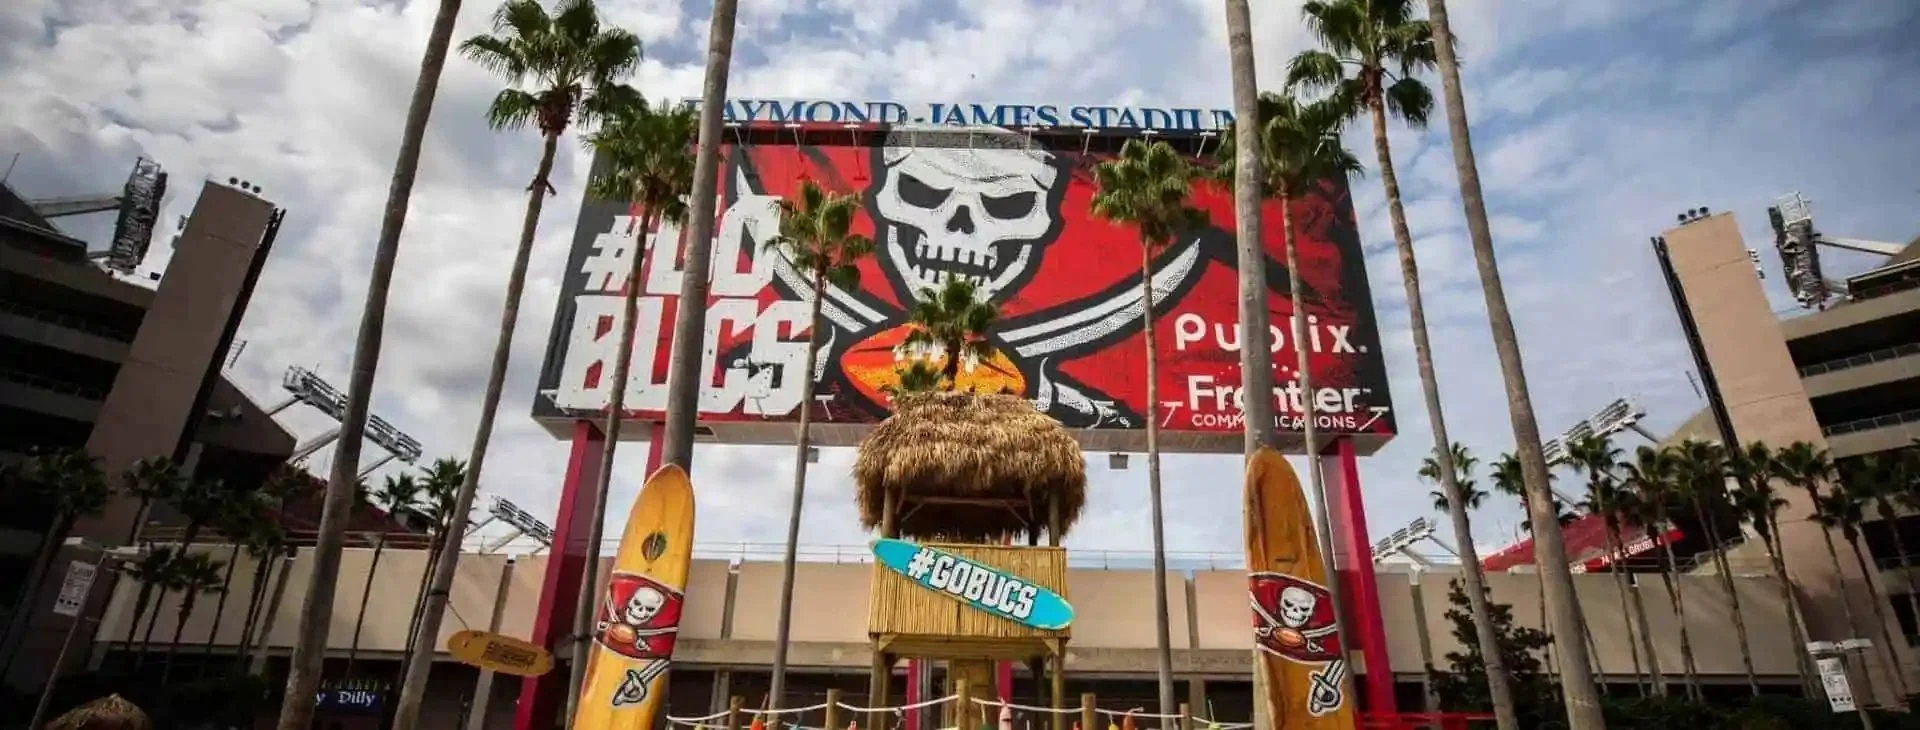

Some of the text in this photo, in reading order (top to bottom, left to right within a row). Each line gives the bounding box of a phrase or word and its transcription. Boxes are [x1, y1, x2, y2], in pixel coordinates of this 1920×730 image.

[684, 99, 908, 124] AYMOND
[928, 103, 1059, 127] JAMES
[555, 296, 812, 416] BUCS
[1188, 375, 1360, 413] Frnter
[1192, 413, 1356, 429] COMMICAIONS
[908, 549, 1037, 619] #GOBUCS
[338, 691, 376, 707] Dilly
